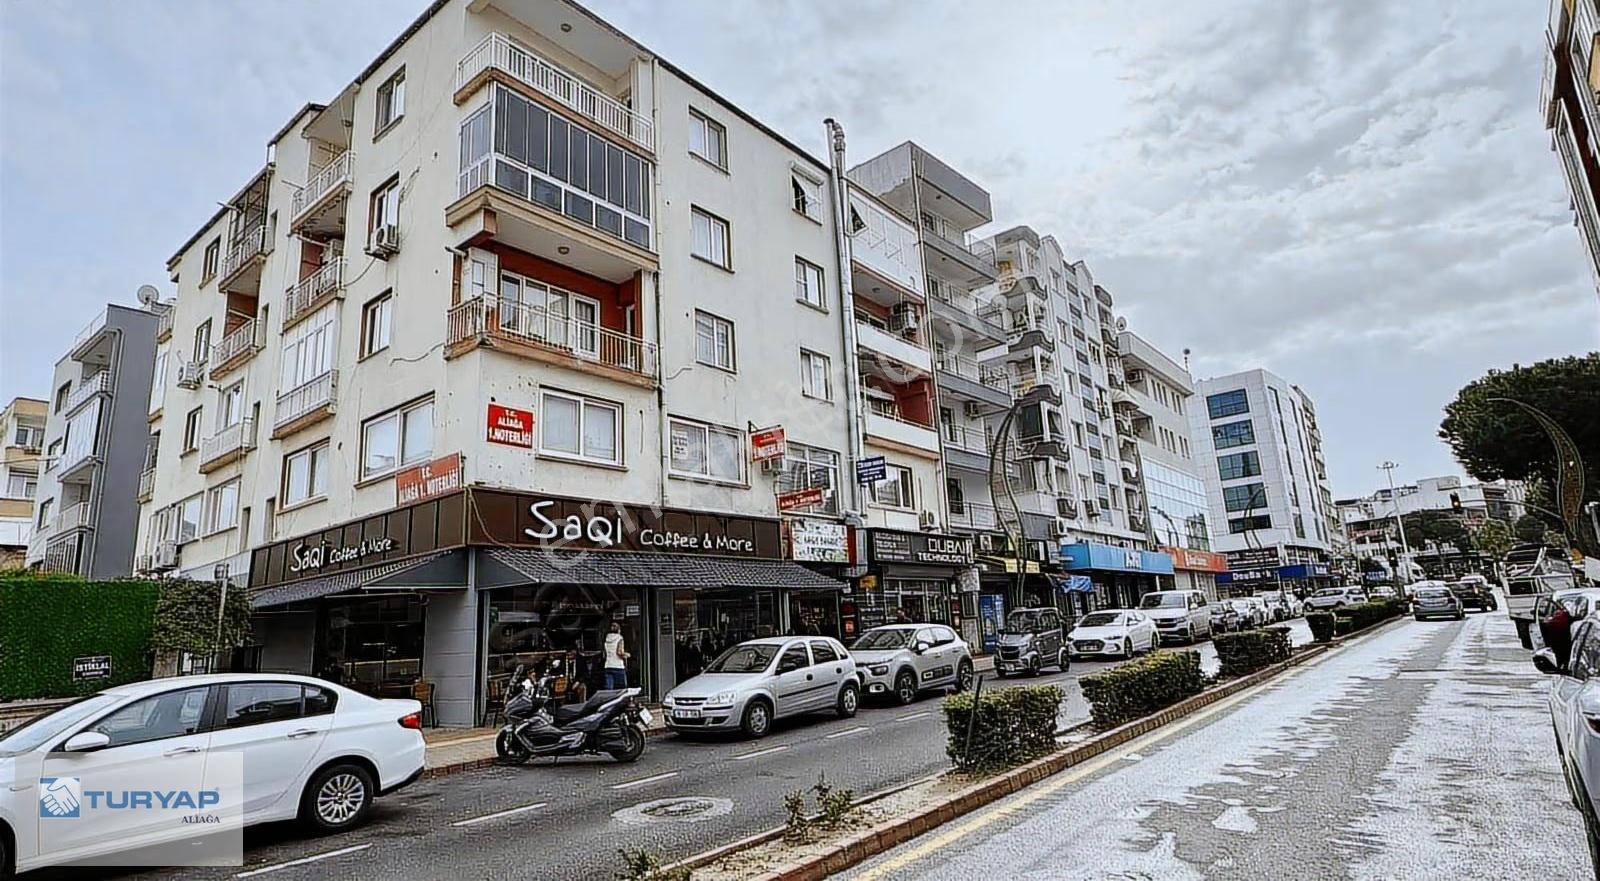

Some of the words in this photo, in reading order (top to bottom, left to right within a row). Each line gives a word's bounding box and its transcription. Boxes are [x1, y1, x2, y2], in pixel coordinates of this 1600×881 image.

[640, 529, 699, 549] Coffee
[703, 533, 712, 549] &
[716, 536, 754, 552] More
[928, 538, 965, 554] DUBAI
[329, 546, 359, 564] Coffee
[367, 538, 392, 554] More
[917, 552, 966, 564] TECHNOLOGY
